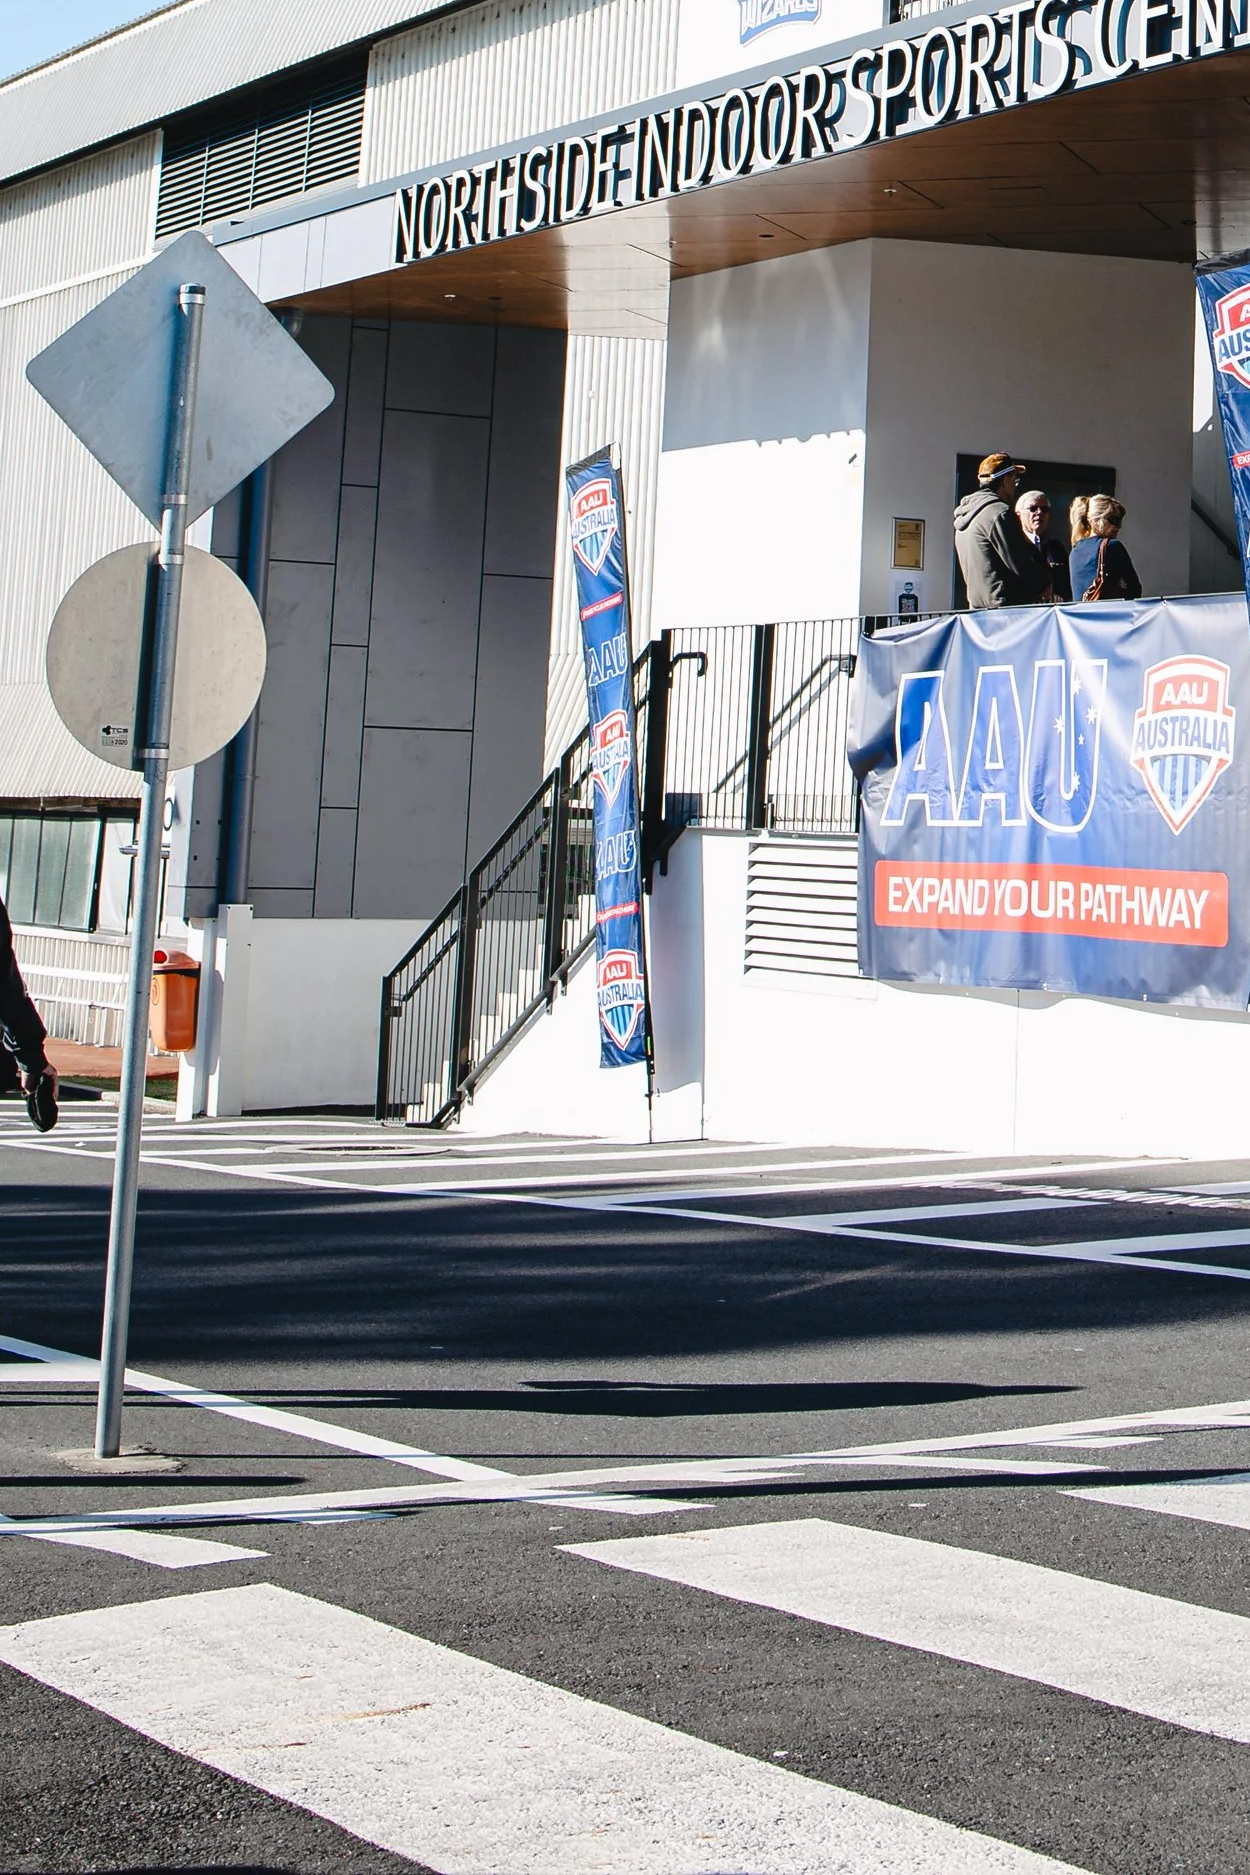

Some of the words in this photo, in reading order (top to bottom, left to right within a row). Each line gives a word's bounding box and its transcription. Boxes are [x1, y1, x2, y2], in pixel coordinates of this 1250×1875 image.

[395, 125, 622, 265] NORTHSIDE
[634, 68, 830, 202] INDOOR
[588, 632, 627, 687] AAU
[1160, 680, 1210, 706] AAU
[879, 658, 1108, 833] AAU
[1136, 714, 1232, 754] AUSTRALIA
[887, 877, 988, 916] EXPAND
[993, 877, 1076, 921] YOUR
[1079, 883, 1211, 931] PATHWAY
